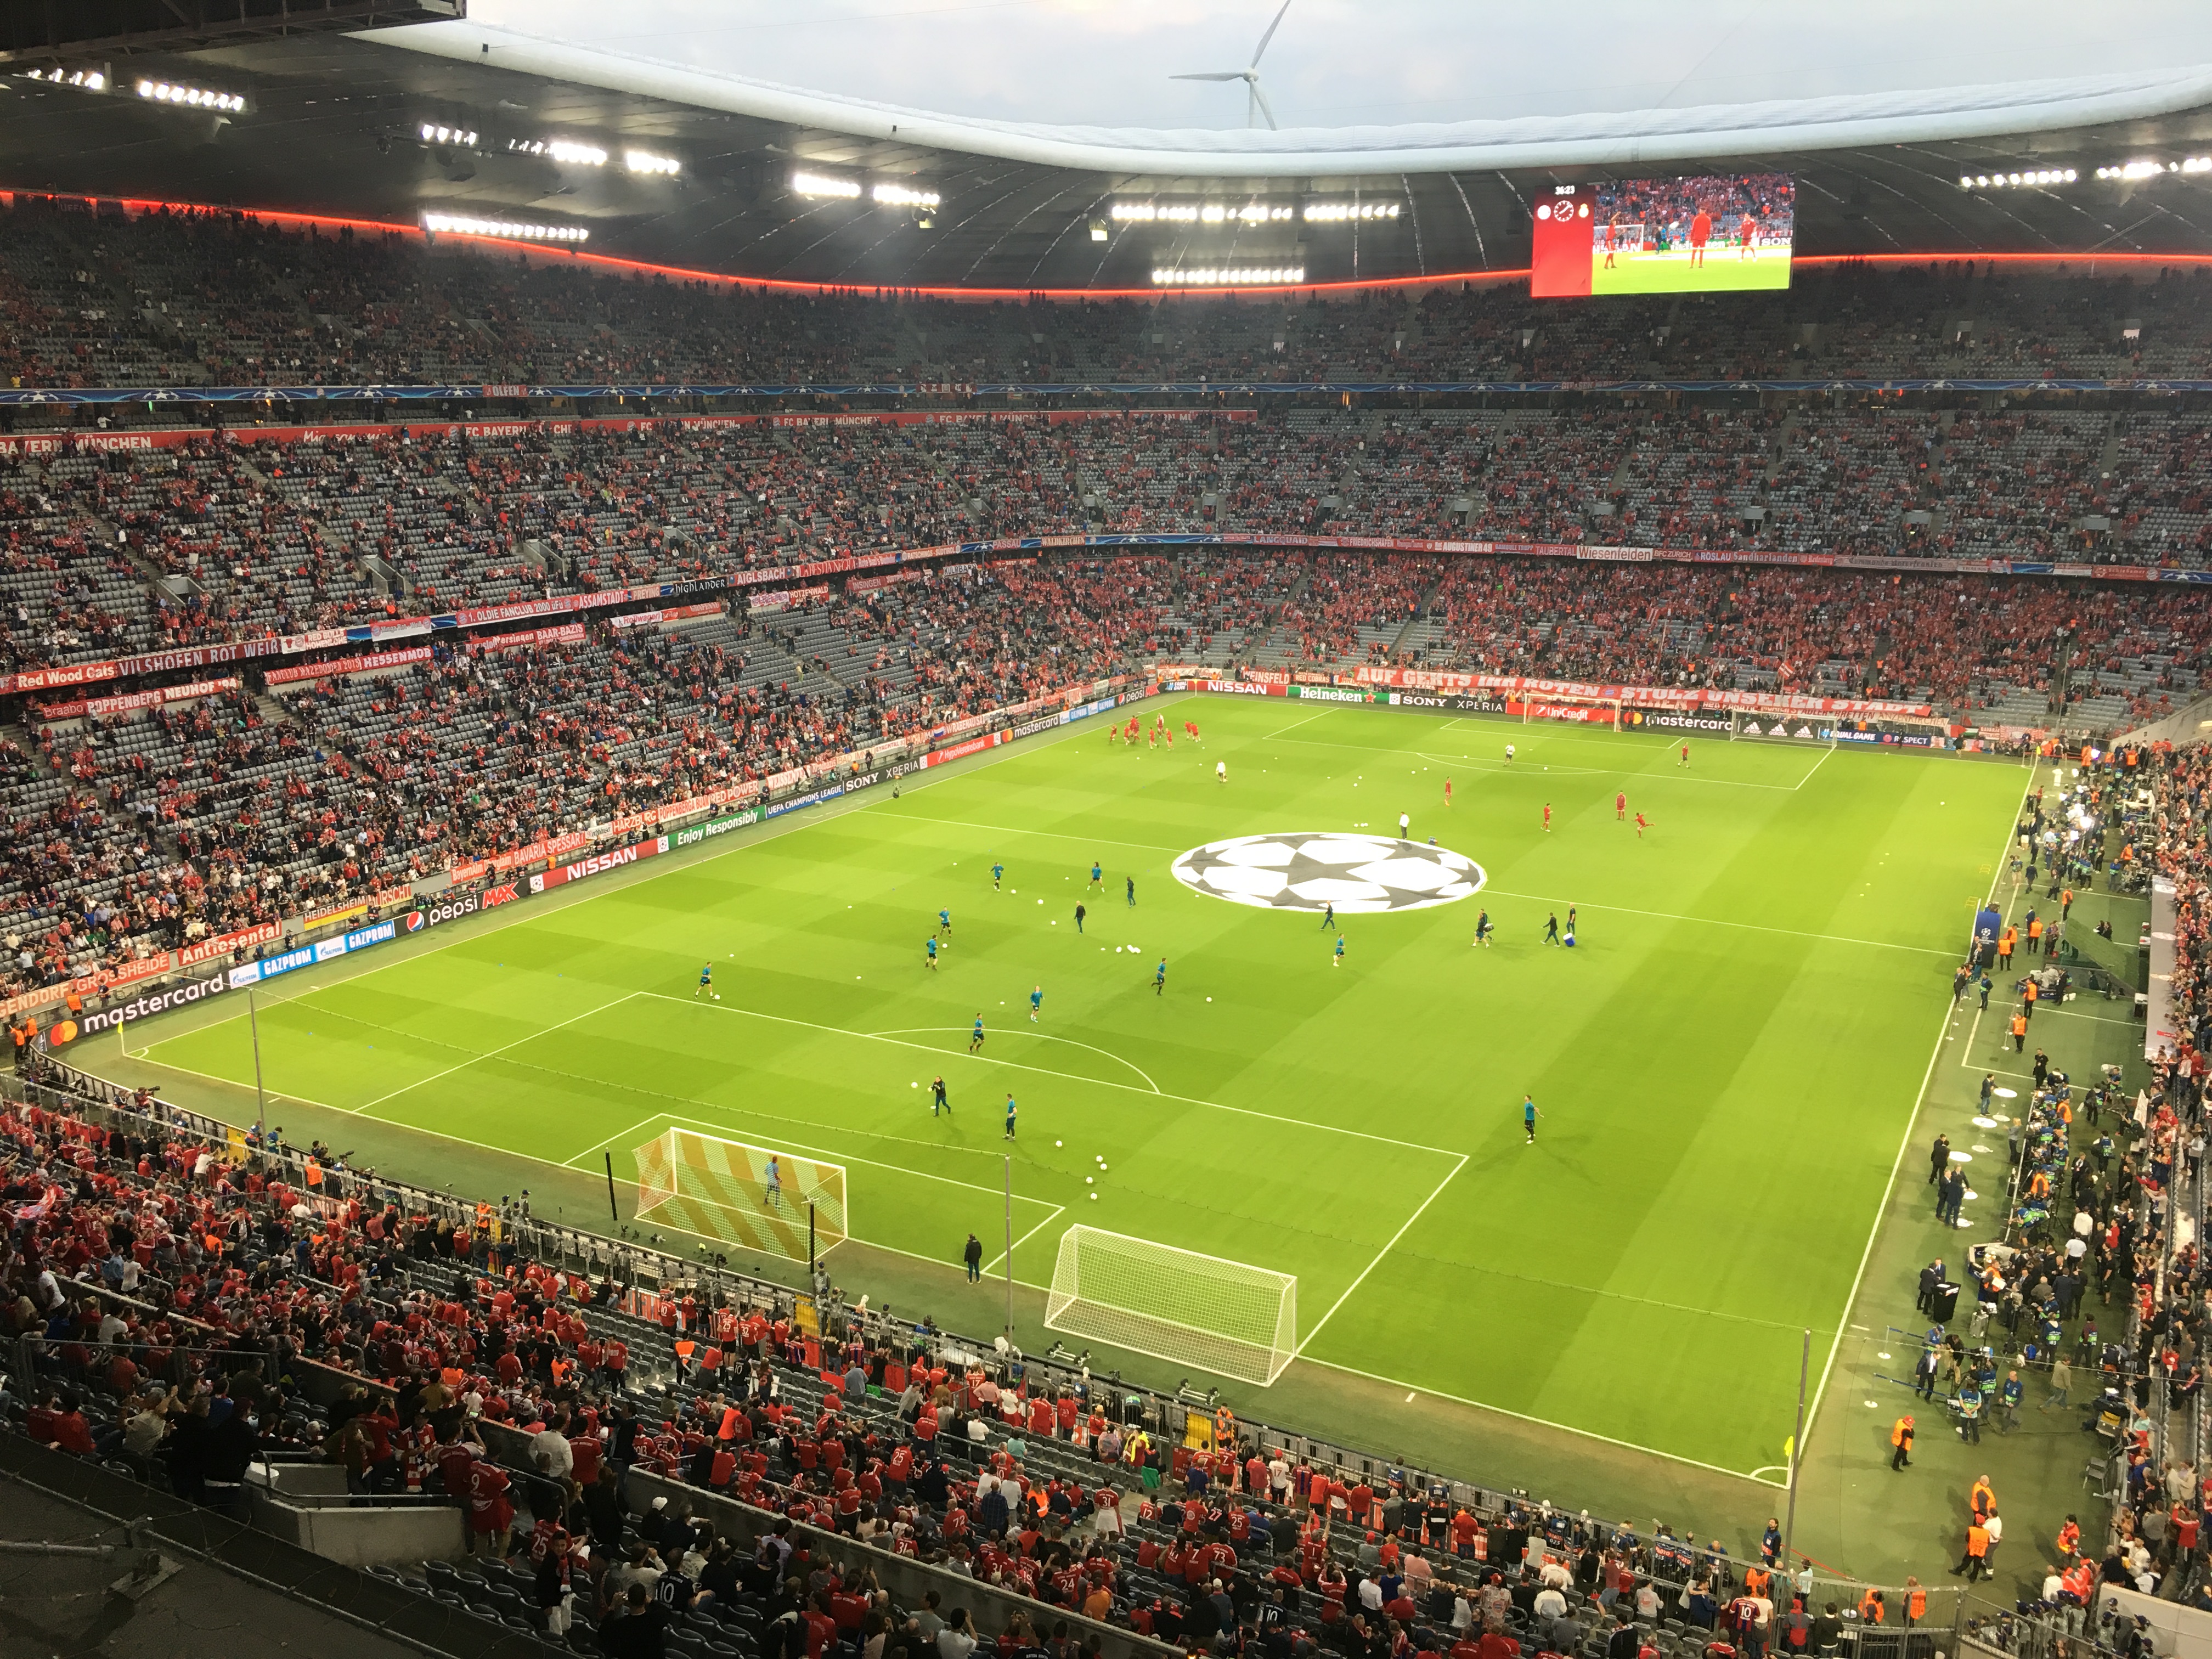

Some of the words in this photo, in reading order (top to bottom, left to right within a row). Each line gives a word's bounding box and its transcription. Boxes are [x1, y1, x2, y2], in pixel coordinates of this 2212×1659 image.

[784, 418, 793, 427] FC
[940, 415, 953, 423] FC
[465, 427, 479, 437] FC
[483, 425, 527, 437] BAYERN
[641, 422, 652, 431] FC
[993, 539, 1021, 549] PASSAU
[1042, 536, 1086, 546] WALDKIRCHEN
[1443, 541, 1483, 552] AUGUSTINER
[1483, 543, 1493, 553] 49
[1536, 546, 1576, 556] TAUBERTAL
[1579, 548, 1651, 561] Wiesenfelden
[737, 567, 785, 585] AIGLSBACH
[853, 578, 882, 590] INSINGEN
[579, 590, 625, 610] ASSAMSTADT
[633, 587, 659, 601] PREYING
[469, 612, 476, 623] 1.
[477, 608, 500, 622] OLDIE
[500, 603, 534, 619] FANCLUB
[533, 601, 551, 614] 2000
[307, 633, 322, 642] RED
[323, 629, 345, 640] BULLS
[536, 624, 584, 640] BAAR-BAZIS
[306, 637, 348, 650] HOHENLOHE
[119, 650, 204, 677] VILSHOFEN
[210, 645, 237, 663] ROT
[363, 646, 432, 668] HESSENMOB
[18, 672, 44, 689] Red
[46, 668, 83, 685] Wood
[85, 665, 115, 680] Cats
[268, 667, 299, 683] FANCLUB
[1308, 675, 1330, 684] COBRAS
[165, 680, 215, 701] NEUHOF
[1126, 688, 1145, 703] pepsi
[1145, 682, 1161, 697] MAX
[1207, 681, 1267, 695] NISSAN
[1300, 686, 1363, 703] Heineken
[1357, 668, 1397, 684] AUF
[1402, 670, 1473, 687] GEHTS
[1523, 678, 1600, 697] ROTEN
[1620, 686, 1700, 701] STOLZ
[1707, 690, 1825, 709] UNSERER
[1831, 699, 1922, 714] STADT
[87, 691, 161, 713] POPPENBERG
[1402, 696, 1448, 708] SONY
[44, 703, 83, 719] Braabo
[1070, 707, 1088, 721] GAZPROM
[1547, 706, 1588, 720] UniCredit
[1877, 713, 1948, 727] ANZENKIRCHEN
[1014, 718, 1058, 738] mastercard
[1853, 732, 1876, 741] GAME
[944, 739, 985, 760] HypoVereinsbank
[838, 754, 851, 765] BAD
[845, 772, 879, 792] SONY
[886, 760, 919, 780] XPERIA
[728, 782, 759, 800] POWER
[768, 803, 785, 815] UEFA
[785, 791, 820, 811] CHAMPIONS
[820, 785, 842, 802] LEAGUE
[659, 803, 695, 822] POPPENBERGA
[678, 826, 703, 845] Enjoy
[706, 810, 758, 837] Responsibly
[514, 846, 546, 865] BAVARIA
[547, 836, 585, 855] SPESSART
[566, 847, 637, 881] NISSAN
[452, 864, 483, 882] BayernAlm
[304, 895, 366, 923] HEIDELSHEIM
[429, 894, 478, 926] pepsi
[482, 882, 520, 909] MAX
[349, 924, 392, 949] GAZPROM
[182, 924, 281, 964] Antiesental
[264, 949, 312, 975] GAZPROM
[76, 956, 168, 992] GROSSHEIDE
[84, 973, 223, 1033] mastercard
[660, 1306, 668, 1317] 10
[723, 1319, 731, 1330] 25
[741, 1326, 749, 1335] 32
[735, 1364, 743, 1375] 10
[972, 1379, 981, 1387] 17
[893, 1451, 905, 1463] 25
[1223, 1455, 1228, 1464] 7
[1273, 1469, 1282, 1477] 17
[471, 1474, 480, 1492] 9
[1101, 1498, 1112, 1508] 31
[1142, 1508, 1152, 1519] 12
[1208, 1509, 1223, 1521] 27
[953, 1515, 966, 1528] 72
[1232, 1516, 1243, 1528] 25
[532, 1533, 547, 1557] 25
[898, 1541, 909, 1554] 31
[1312, 1547, 1316, 1557] 1
[1193, 1549, 1200, 1560] 7
[1214, 1550, 1226, 1564] 73
[1061, 1578, 1075, 1590] 24
[659, 1582, 675, 1604] 10
[1267, 1608, 1278, 1622] 10
[1741, 1606, 1752, 1618] 10
